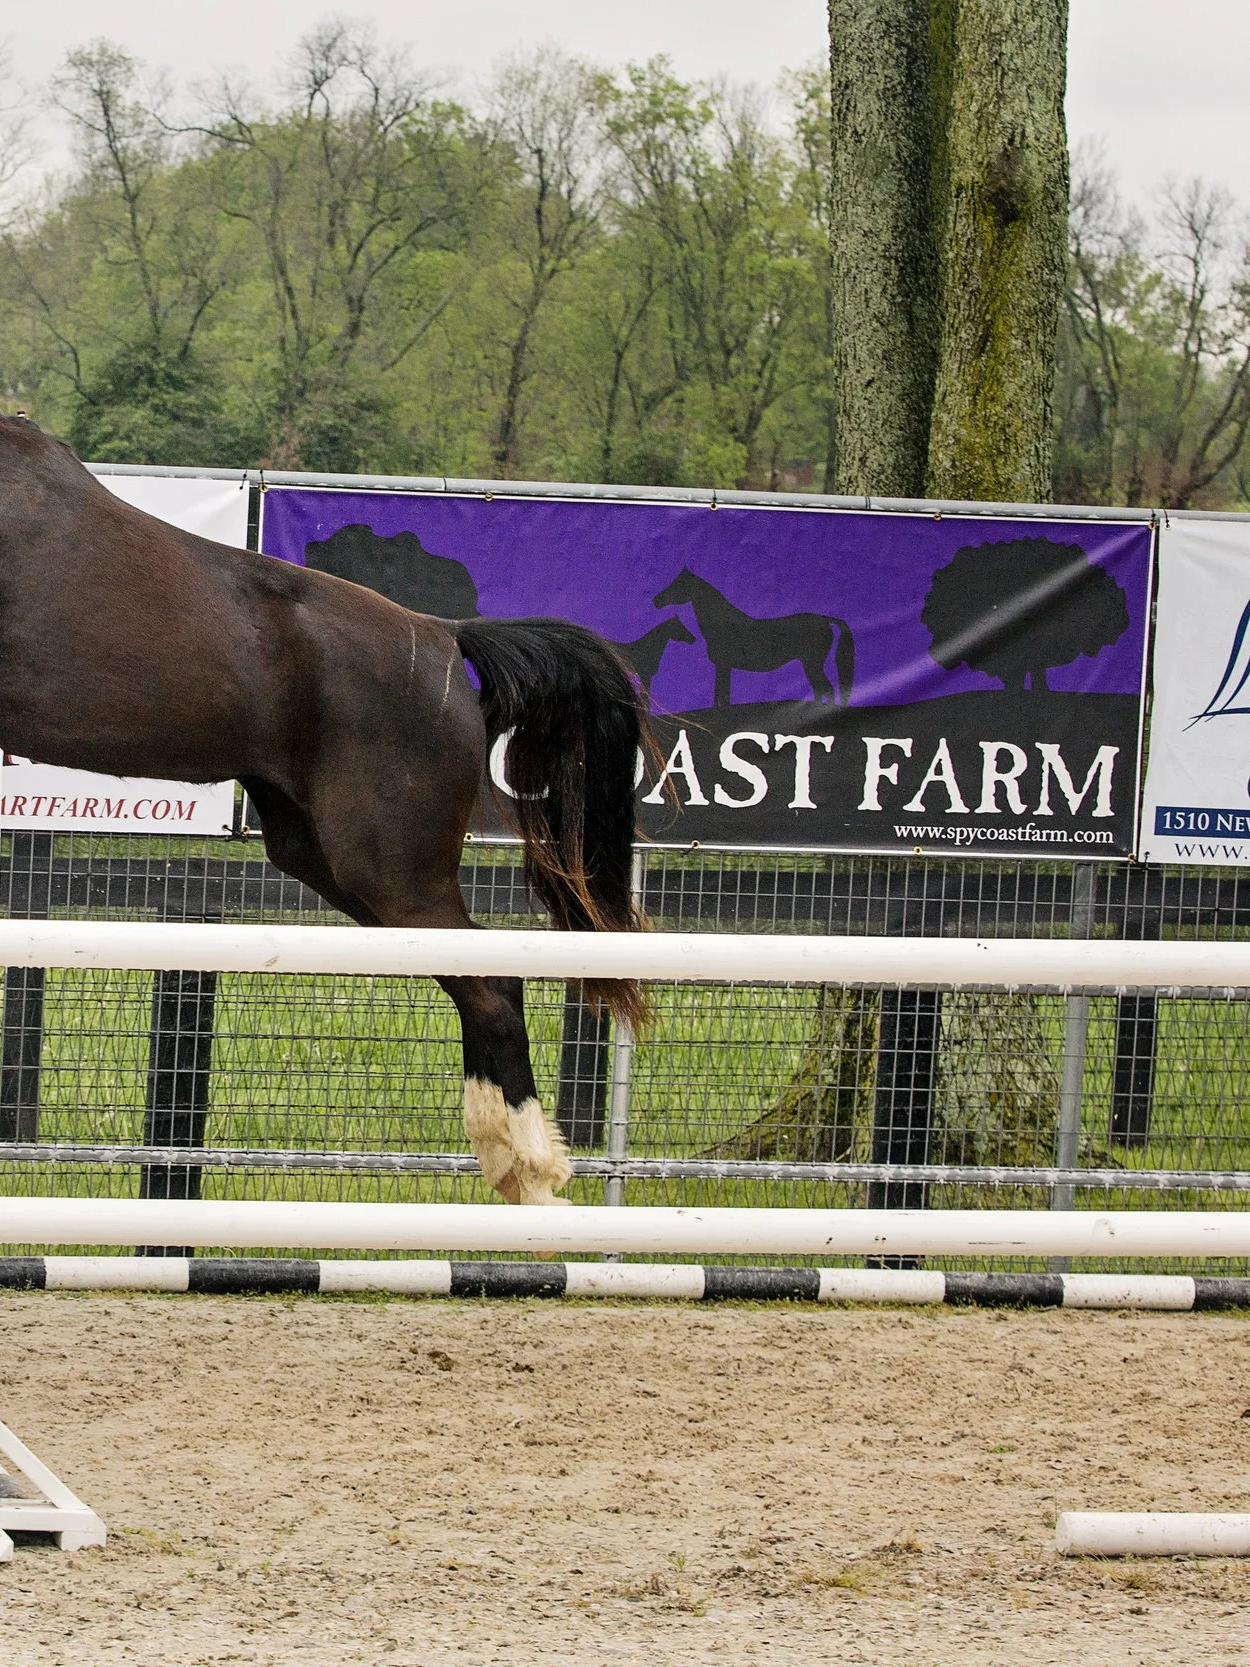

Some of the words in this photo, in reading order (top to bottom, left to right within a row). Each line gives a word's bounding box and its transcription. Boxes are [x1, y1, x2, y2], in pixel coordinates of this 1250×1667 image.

[489, 726, 834, 809] CAST
[857, 737, 1120, 818] FARM
[1163, 812, 1210, 831] 1510
[893, 823, 1114, 845] www.spycoastfarm.com
